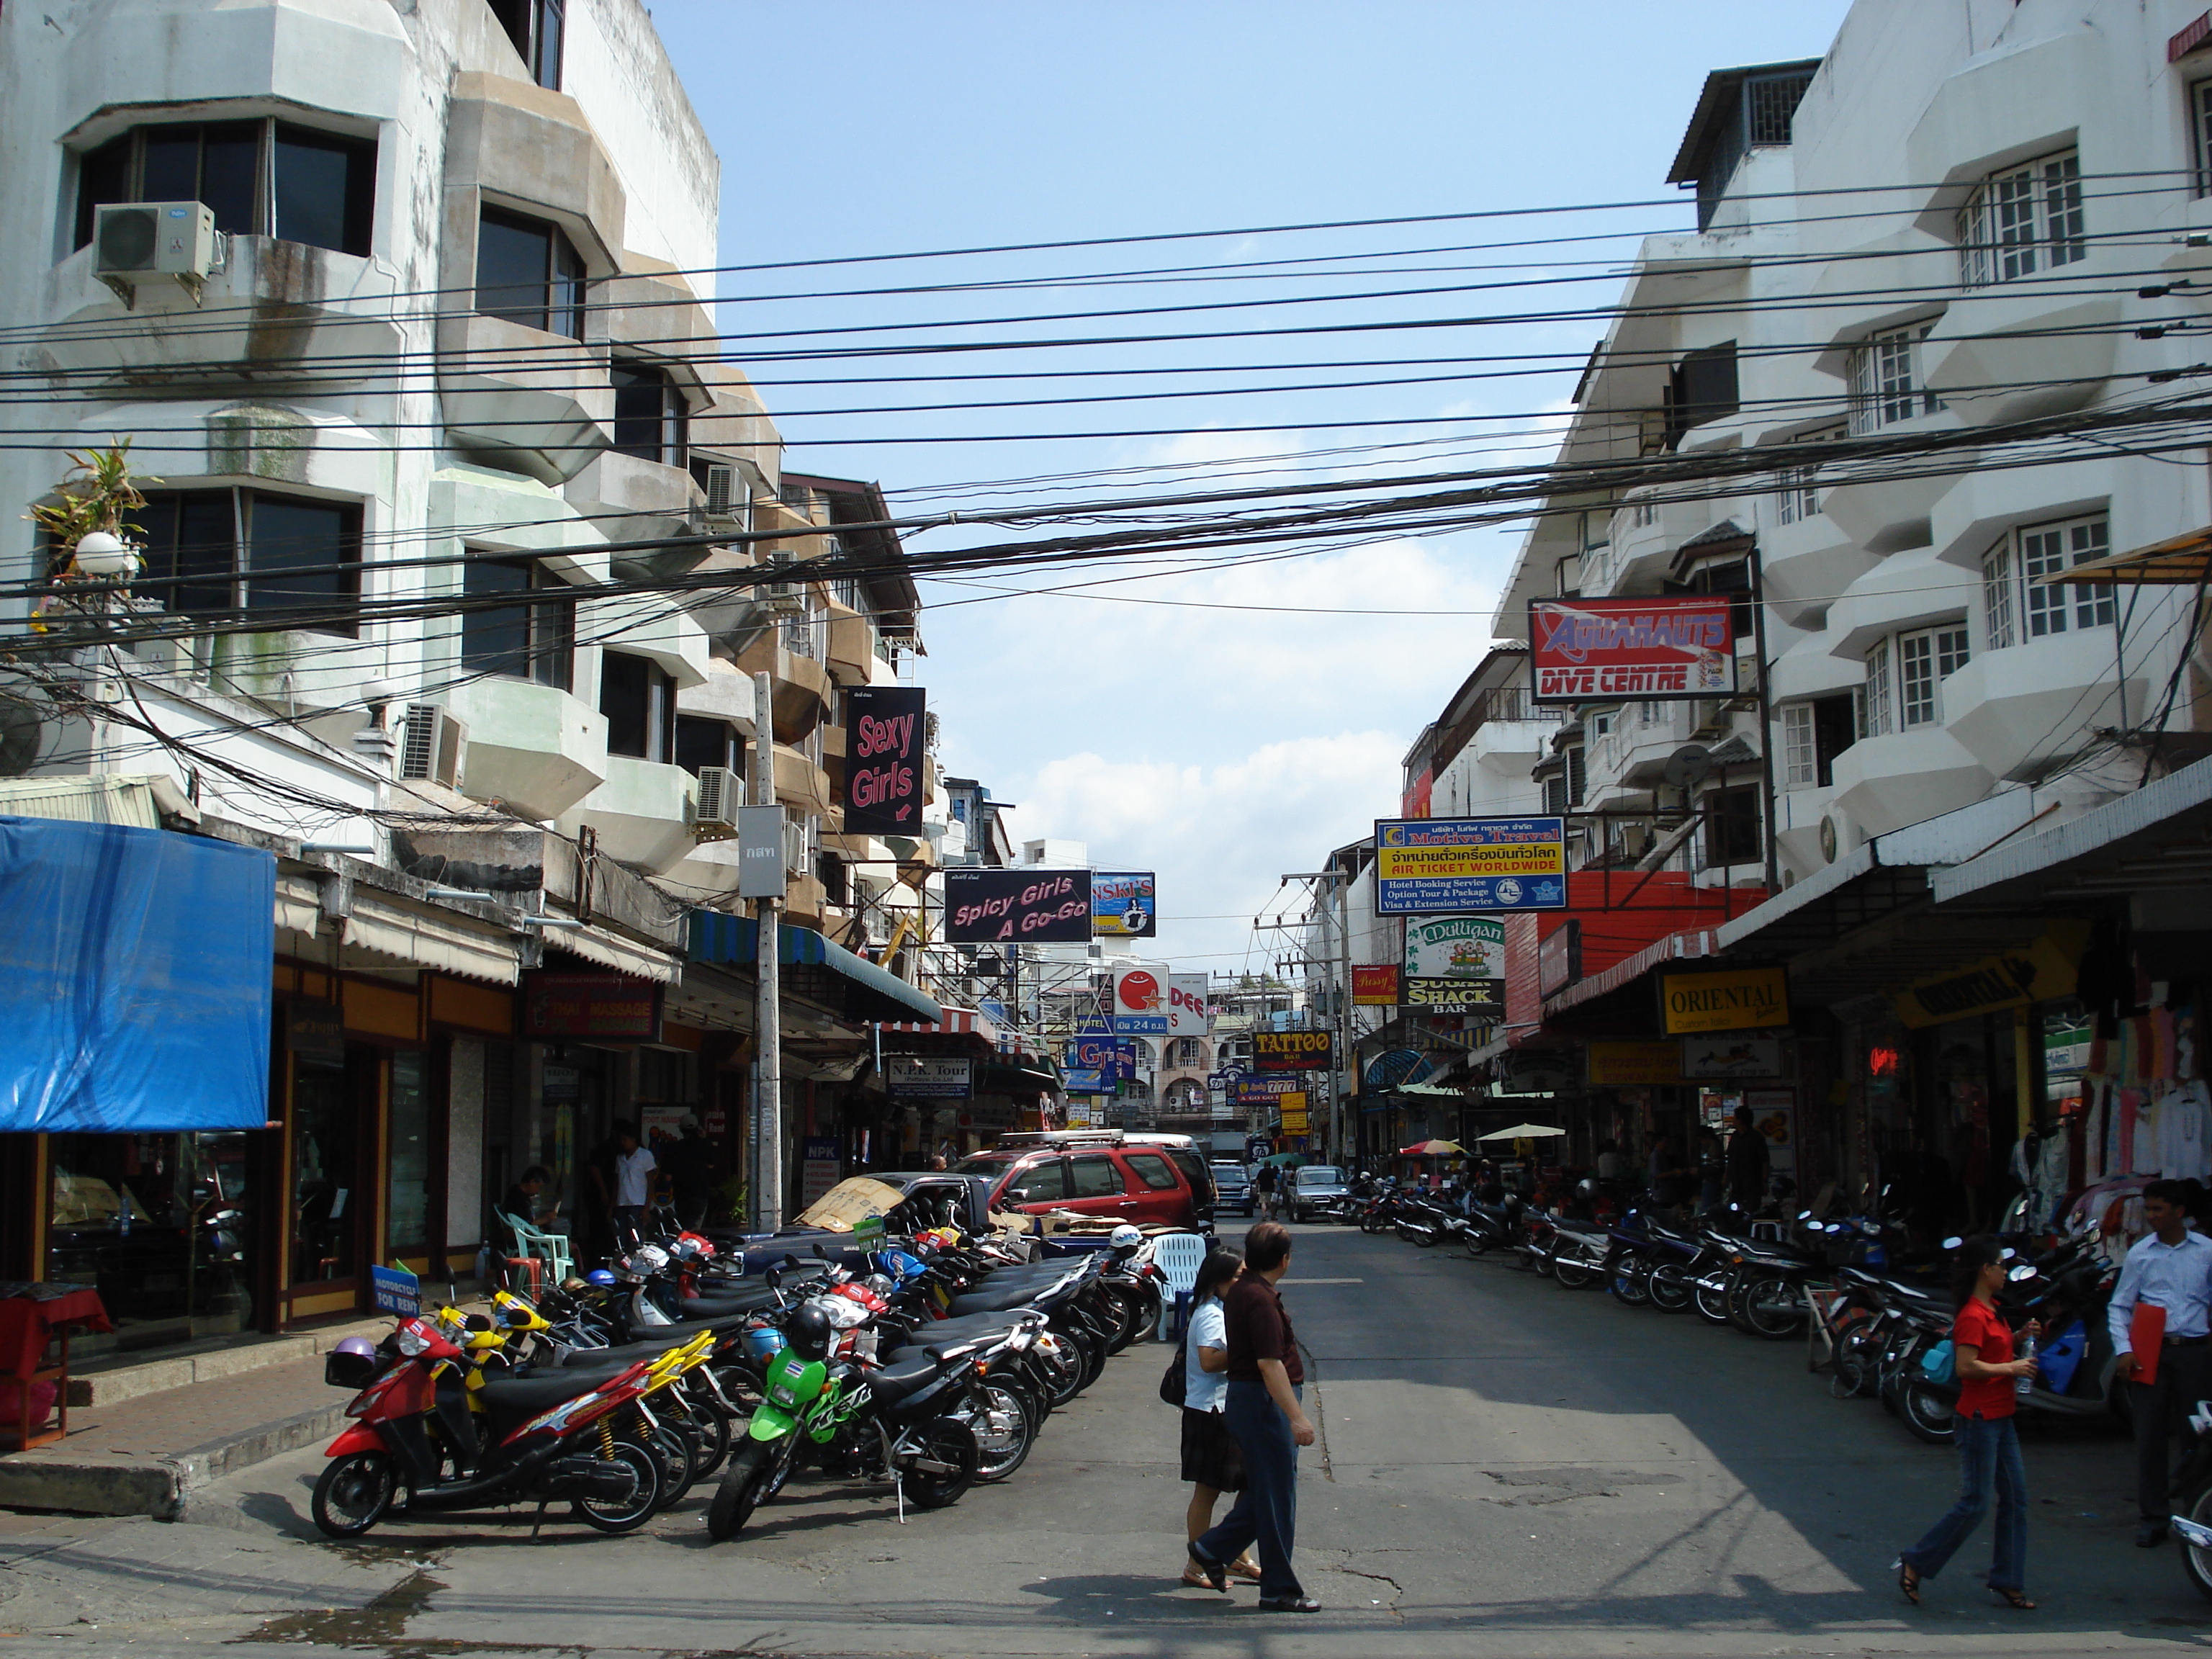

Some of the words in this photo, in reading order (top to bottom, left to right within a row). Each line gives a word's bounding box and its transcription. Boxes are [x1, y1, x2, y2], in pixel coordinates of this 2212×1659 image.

[1540, 667, 1596, 694] DIVE
[1600, 664, 1688, 693] CENTRE
[858, 714, 914, 758] Sexy
[853, 761, 913, 807] Girls
[1408, 831, 1484, 845] Motive
[1488, 828, 1560, 842] Travel
[1391, 865, 1414, 875] AIR
[1419, 863, 1465, 873] TICKET
[1470, 860, 1556, 872] WORLDWIDE
[1415, 880, 1452, 889] Booking
[1453, 878, 1486, 887] Service
[955, 895, 1015, 927] Spicy
[1020, 876, 1073, 907] Girls
[1387, 891, 1418, 900] Option
[1452, 889, 1489, 897] Package
[1460, 897, 1493, 906] Service
[997, 919, 1014, 942] A
[1020, 900, 1089, 933] Go-Go
[1423, 920, 1503, 943] Mulligan
[1357, 974, 1388, 990] Pussy
[1408, 989, 1493, 1004] SHACK
[1671, 984, 1780, 1013] ORIENTAL
[590, 1002, 651, 1016] MASSAGE
[1433, 1004, 1467, 1014] BAR
[1133, 1020, 1148, 1030] 24
[1675, 1019, 1708, 1030] Custom
[1256, 1033, 1329, 1053] TATTOO
[893, 1065, 931, 1075] N.P.K.
[935, 1065, 967, 1075] Tour
[808, 1146, 835, 1158] NPK
[376, 1278, 416, 1296] MOTORCYCLE
[377, 1292, 395, 1308] FOR
[397, 1298, 417, 1314] RENT
